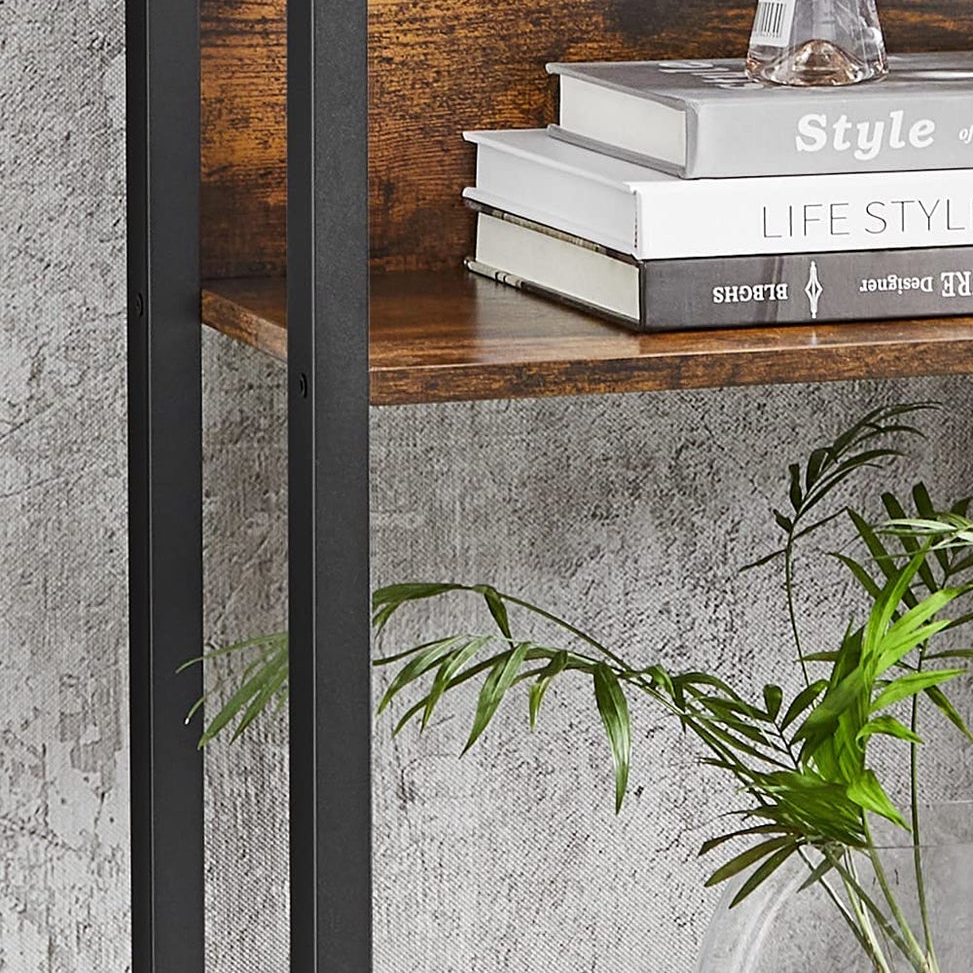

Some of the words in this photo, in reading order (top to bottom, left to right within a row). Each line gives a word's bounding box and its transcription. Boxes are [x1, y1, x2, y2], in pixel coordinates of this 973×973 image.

[795, 109, 935, 161] Style
[763, 201, 850, 239] LIFE
[712, 283, 789, 304] BLBGHS
[859, 274, 934, 295] Designer
